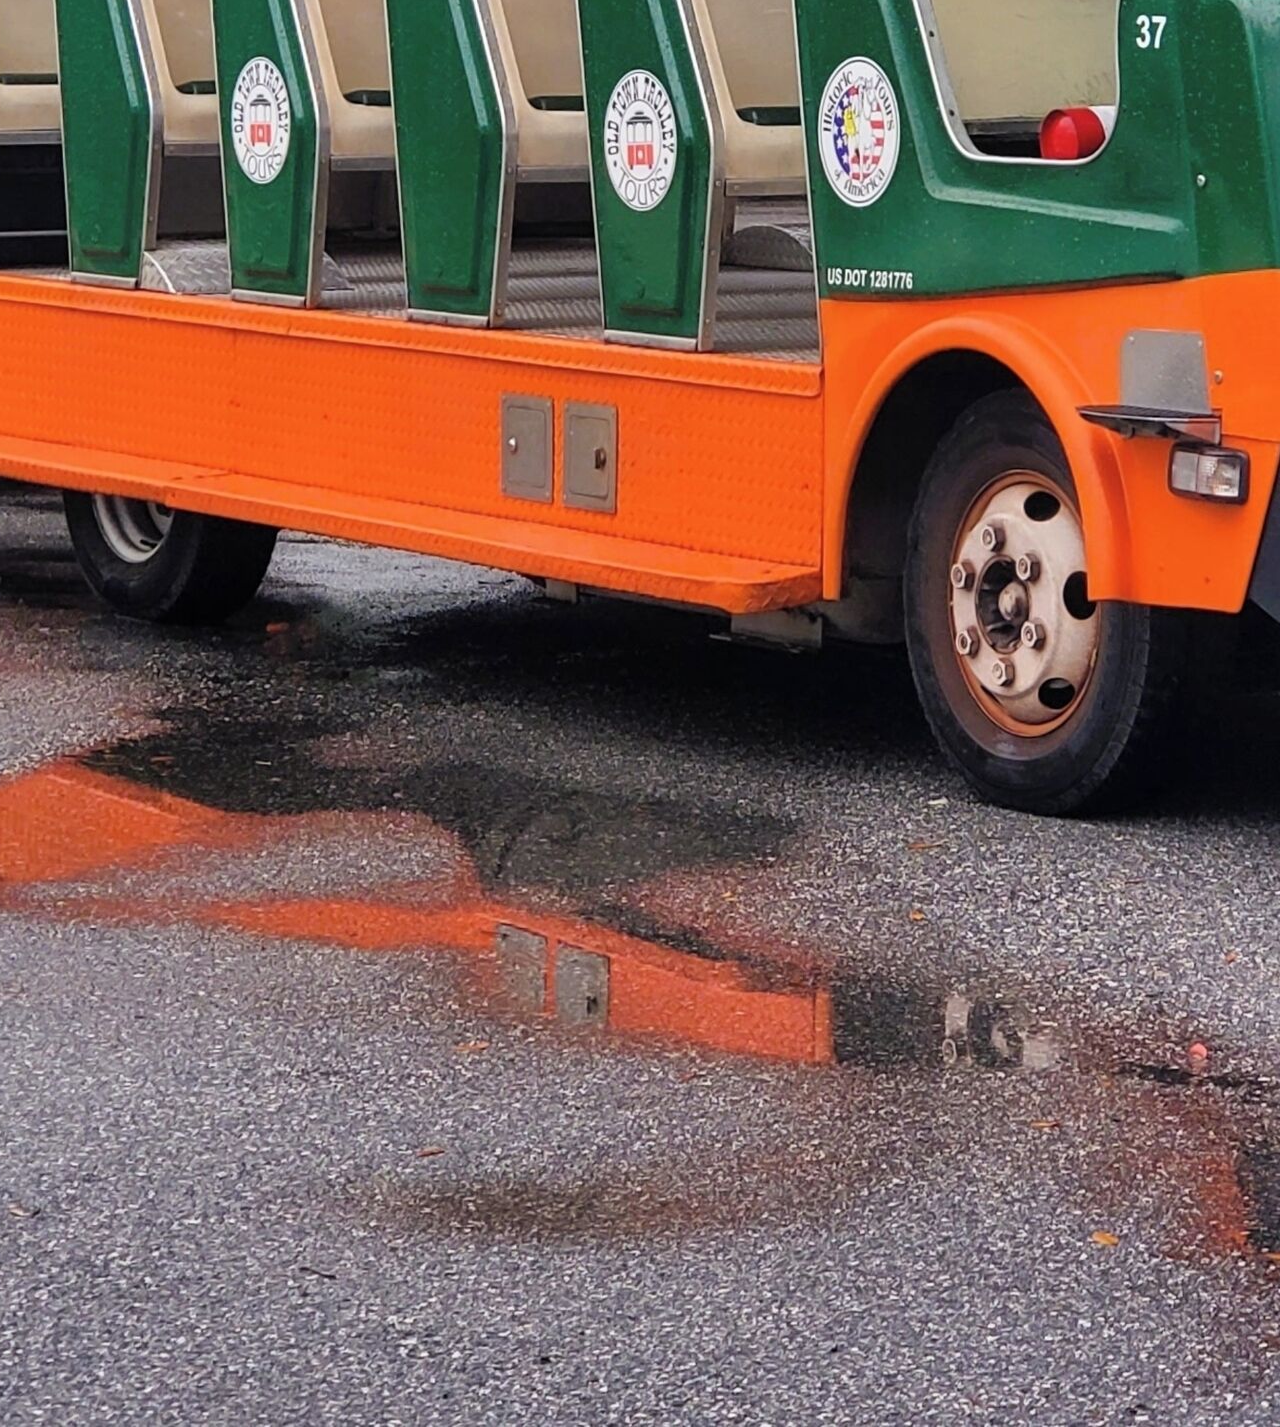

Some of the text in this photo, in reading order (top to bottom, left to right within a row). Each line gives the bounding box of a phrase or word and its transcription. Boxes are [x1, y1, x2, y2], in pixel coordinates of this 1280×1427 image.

[1136, 15, 1167, 49] 37
[234, 102, 244, 133] OLD
[607, 75, 675, 156] OLD TOWN TROLLEY
[823, 71, 895, 132] Historic Tours
[243, 143, 282, 178] TOURS
[617, 167, 667, 205] TOURS
[844, 168, 885, 197] America
[827, 268, 913, 289] US DOT 1281776
